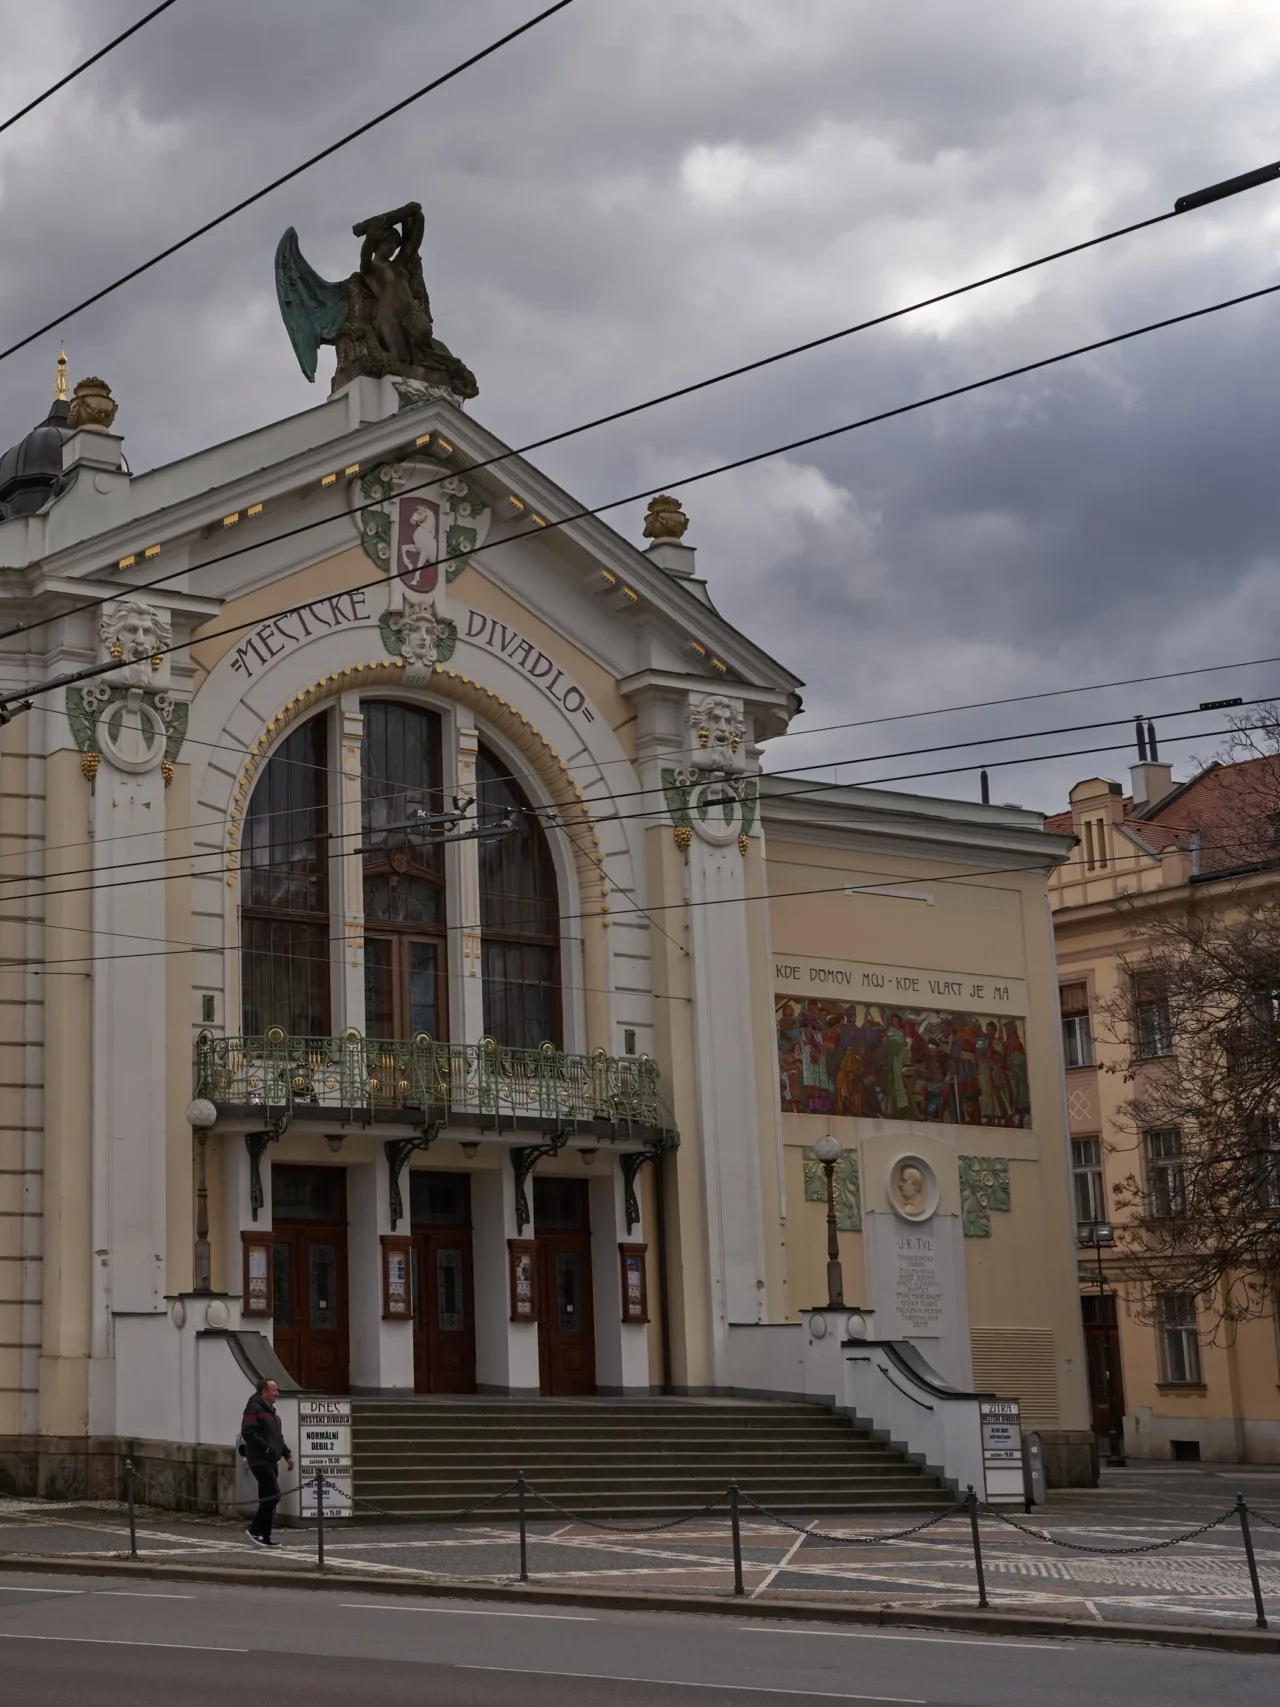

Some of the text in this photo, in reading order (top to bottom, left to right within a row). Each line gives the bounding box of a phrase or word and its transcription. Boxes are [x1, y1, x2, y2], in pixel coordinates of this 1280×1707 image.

[775, 964, 801, 980] KDE
[809, 968, 852, 985] DOMOV
[896, 976, 920, 992] KDE
[928, 980, 963, 996] VLAST
[970, 984, 985, 999] JE
[994, 985, 1010, 1001] MÁ
[310, 1402, 341, 1414] DNES
[326, 1415, 350, 1424] DIVADLO
[306, 1429, 339, 1440] NORMÁLNÍ
[311, 1441, 335, 1450] DEBIL 2
